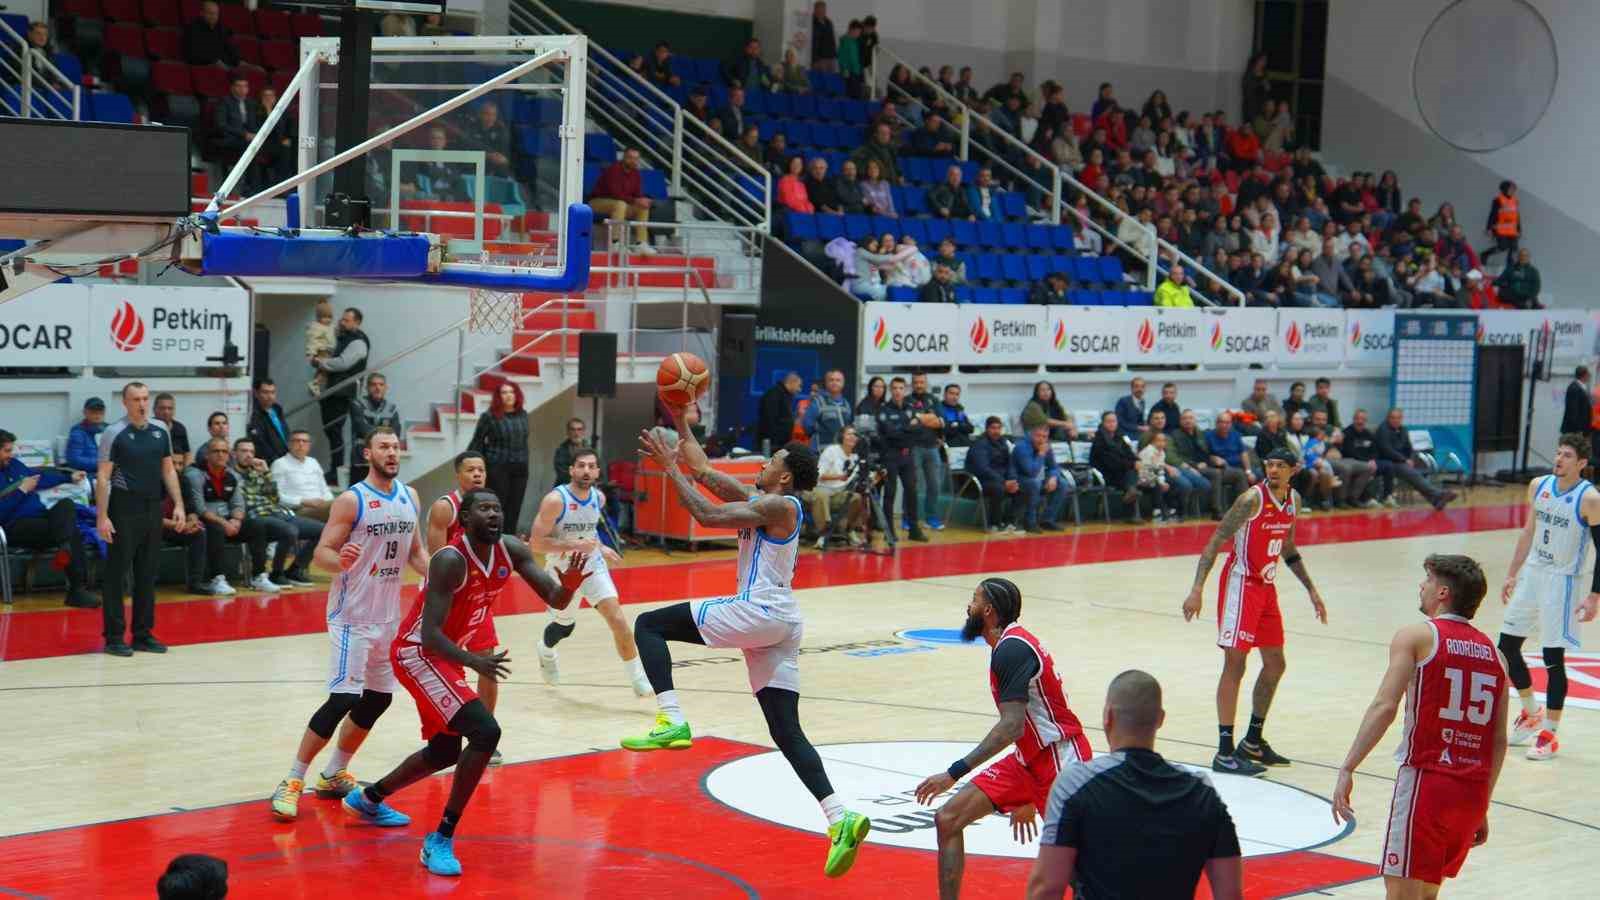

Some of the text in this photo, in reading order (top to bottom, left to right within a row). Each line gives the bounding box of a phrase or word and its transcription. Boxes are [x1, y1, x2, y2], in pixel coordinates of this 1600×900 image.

[153, 307, 229, 330] Petkim
[0, 324, 72, 350] OCAR
[755, 326, 835, 345] irlikteHedefe
[993, 320, 1037, 338] Petkim
[1158, 322, 1197, 338] Petkim
[1304, 323, 1340, 338] Petkim
[152, 338, 205, 351] SPOR
[892, 334, 949, 352] SOCAR
[1071, 335, 1120, 352] SOCAR
[1225, 335, 1270, 352] SOCAR
[1363, 334, 1394, 350] SOCA
[366, 522, 397, 536] PETKIM
[1543, 528, 1550, 545] 6
[385, 541, 398, 560] 19
[1267, 538, 1283, 557] 00
[467, 605, 488, 626] 21
[1439, 667, 1498, 726] 15
